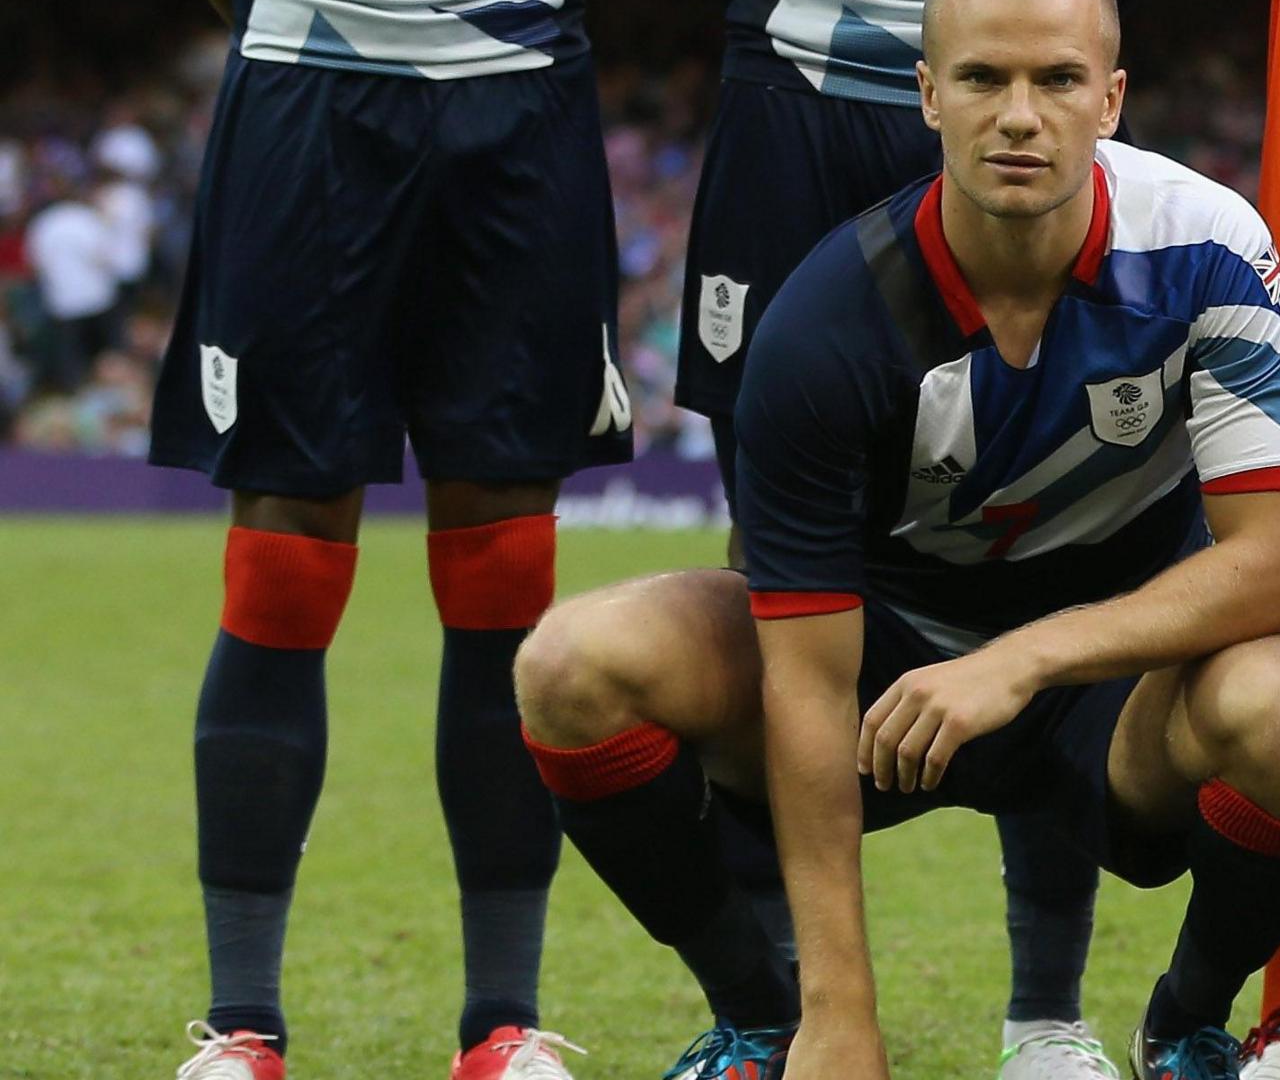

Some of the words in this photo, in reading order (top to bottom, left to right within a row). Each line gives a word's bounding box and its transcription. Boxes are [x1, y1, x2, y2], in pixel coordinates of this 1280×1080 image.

[1110, 406, 1135, 417] TEAM
[1137, 401, 1149, 411] GB
[981, 502, 1039, 560] 7
